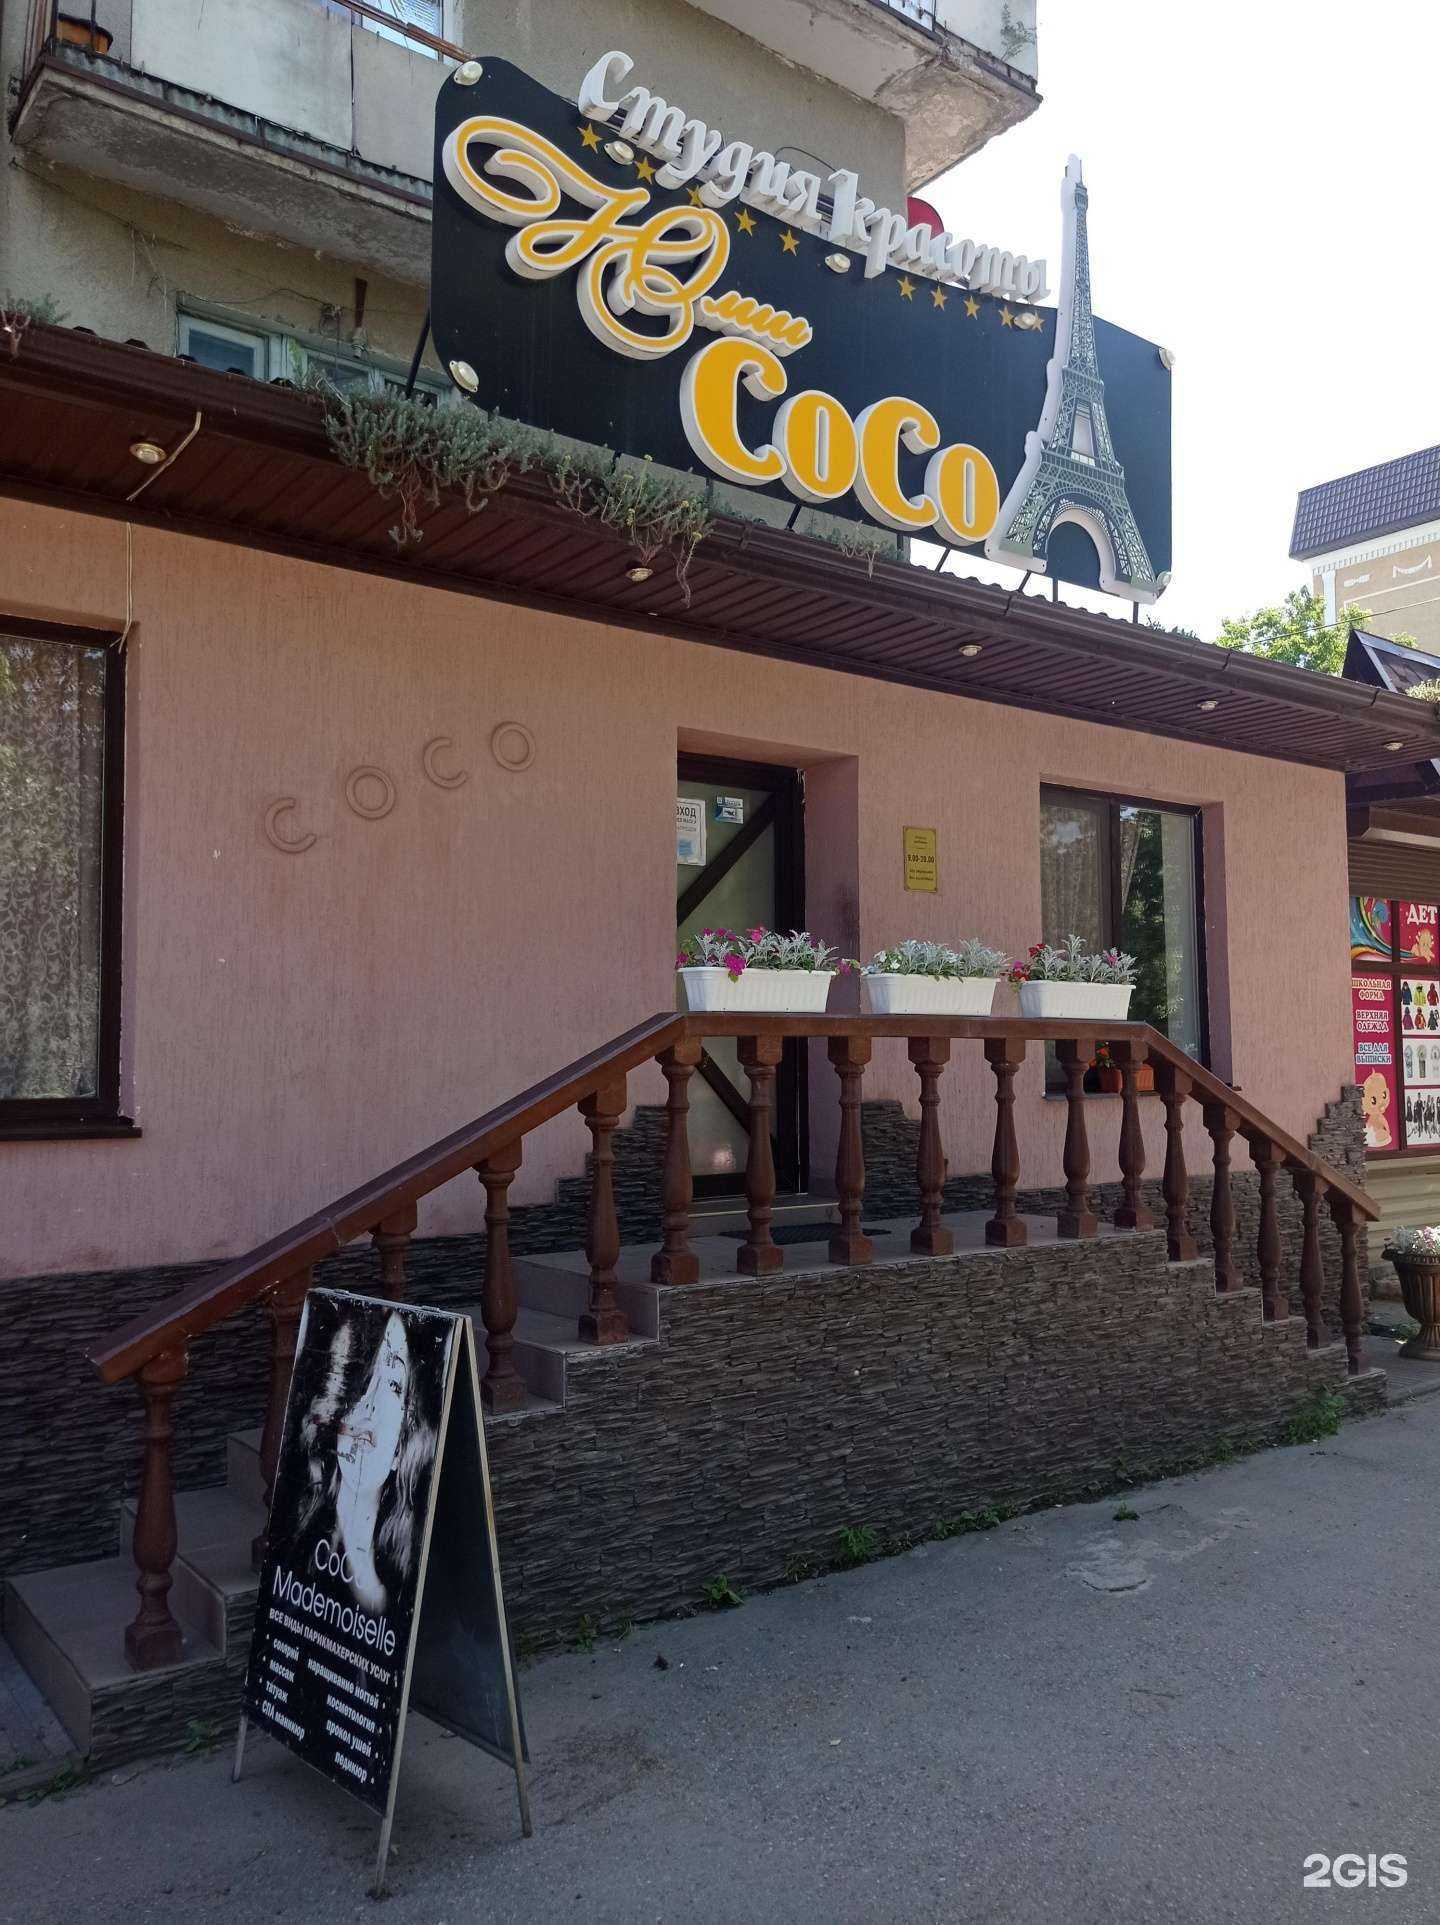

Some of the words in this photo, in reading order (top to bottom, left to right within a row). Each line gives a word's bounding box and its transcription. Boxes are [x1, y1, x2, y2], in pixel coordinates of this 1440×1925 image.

[579, 51, 822, 224] Студия
[1407, 903, 1438, 925] ДЕТ
[1352, 978, 1391, 990] ШКОЛЬНАЯ
[1359, 990, 1384, 1001] ФОРМА
[1356, 1010, 1388, 1021] ВЕРХНЯЯ
[1357, 1021, 1389, 1033] ОДЕЖДА
[1356, 1053, 1392, 1065] ВЫПИСКИ
[1358, 1042, 1371, 1053] ВСЕ
[1372, 1043, 1388, 1055] ДЛЯ
[272, 1565, 396, 1656] Mademoiselle
[269, 1608, 283, 1624] ВСЕ
[284, 1614, 304, 1637] ВИДЫ
[303, 1623, 370, 1673] ПАРИКМАХЕРСКИХ
[369, 1663, 391, 1685] УСЛУГ
[269, 1659, 295, 1683] массаж
[265, 1680, 288, 1703] татуаж
[307, 1658, 355, 1694] наращивание
[354, 1685, 379, 1709] ногтей
[262, 1699, 275, 1719] СПА
[274, 1711, 305, 1741] маникюр
[326, 1693, 376, 1733] косметология
[326, 1719, 351, 1745] прокол
[350, 1735, 372, 1758] ушей
[334, 1751, 368, 1783] педикюр
